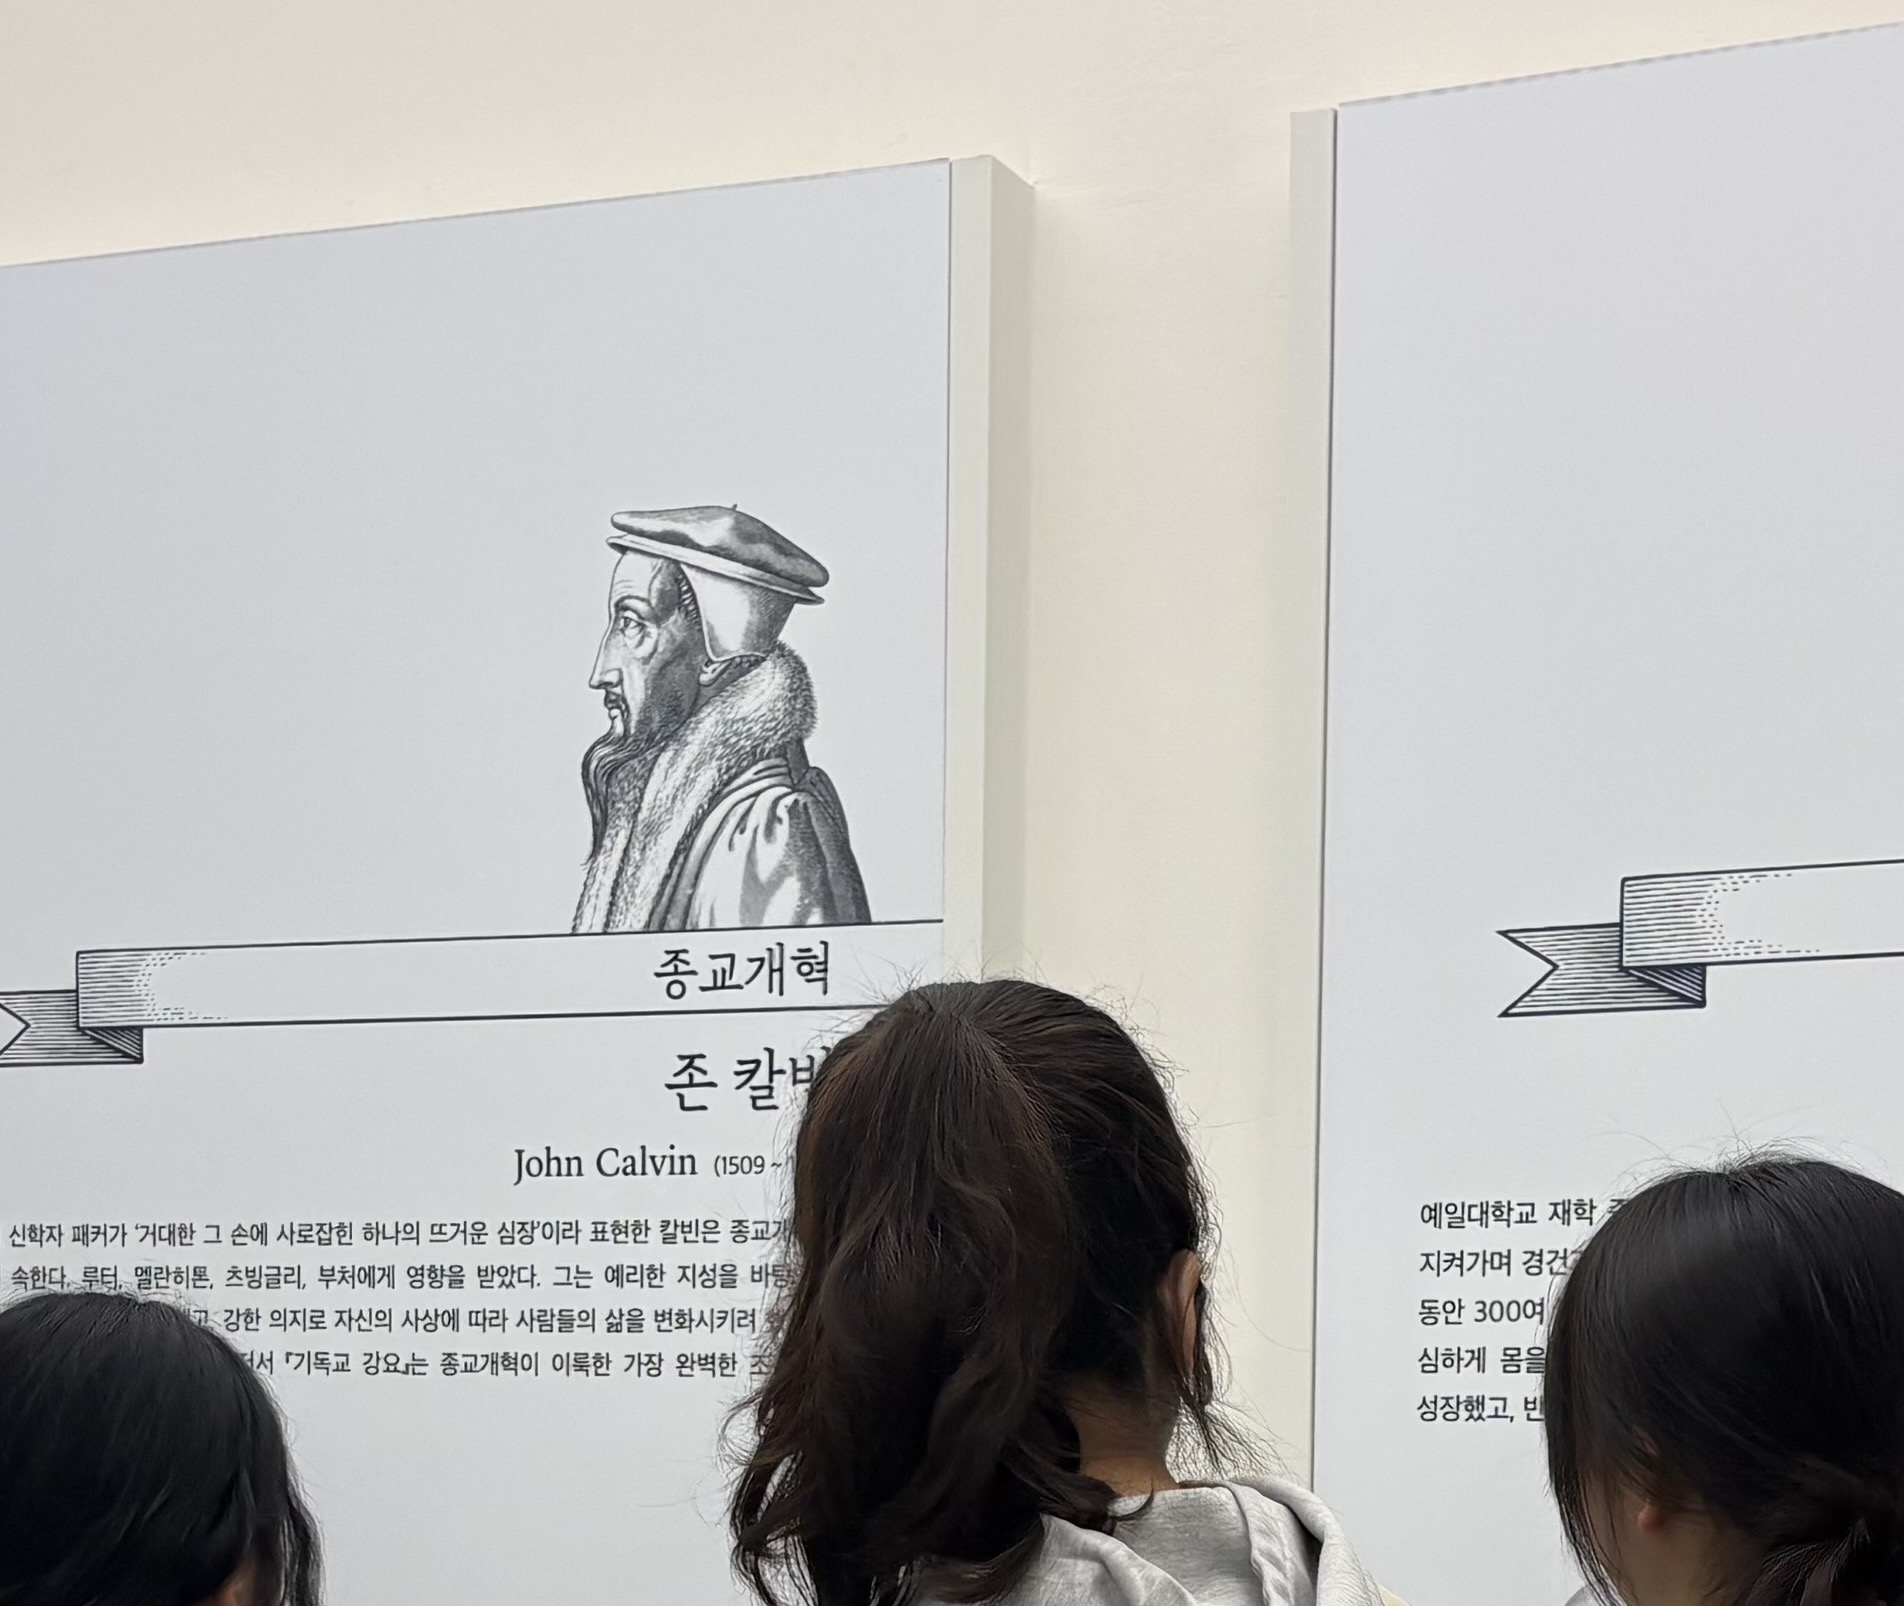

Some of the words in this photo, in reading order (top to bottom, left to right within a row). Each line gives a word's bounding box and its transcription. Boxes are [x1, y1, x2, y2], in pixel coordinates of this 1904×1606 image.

[653, 940, 829, 1001] 종교개혁
[664, 1053, 719, 1112] 존
[513, 1145, 585, 1186] John
[595, 1144, 699, 1178] Calvin
[1420, 1199, 1538, 1230] 예일대학교
[1547, 1197, 1597, 1227] 재학
[8, 1223, 65, 1249] 신학자
[71, 1222, 128, 1249] 패커가
[202, 1224, 223, 1244] 그
[230, 1221, 268, 1247] 손에
[276, 1221, 354, 1247] 사로잡힌
[361, 1220, 420, 1247] 하나의
[428, 1220, 489, 1246] 뜨거운
[589, 1218, 652, 1245] 표현한
[659, 1218, 722, 1245] 칼빈은
[1419, 1248, 1512, 1278] 지켜가며
[223, 1307, 264, 1333] 강한
[268, 1307, 328, 1333] 의지로
[333, 1307, 393, 1334] 자신의
[400, 1307, 460, 1334] 사상에
[468, 1307, 509, 1334] 따라
[515, 1307, 596, 1334] 사람들의
[604, 1307, 646, 1334] 삶을
[653, 1307, 757, 1334] 변화시키려
[1418, 1297, 1466, 1327] 동안
[439, 1351, 539, 1377] 종교개혁이
[551, 1351, 613, 1378] 이룩한
[623, 1351, 665, 1378] 가장
[675, 1351, 738, 1379] 완벽한
[1417, 1345, 1487, 1375] 심하게
[1499, 1346, 1547, 1375] 몸을
[1416, 1394, 1515, 1424] 성장했고,
